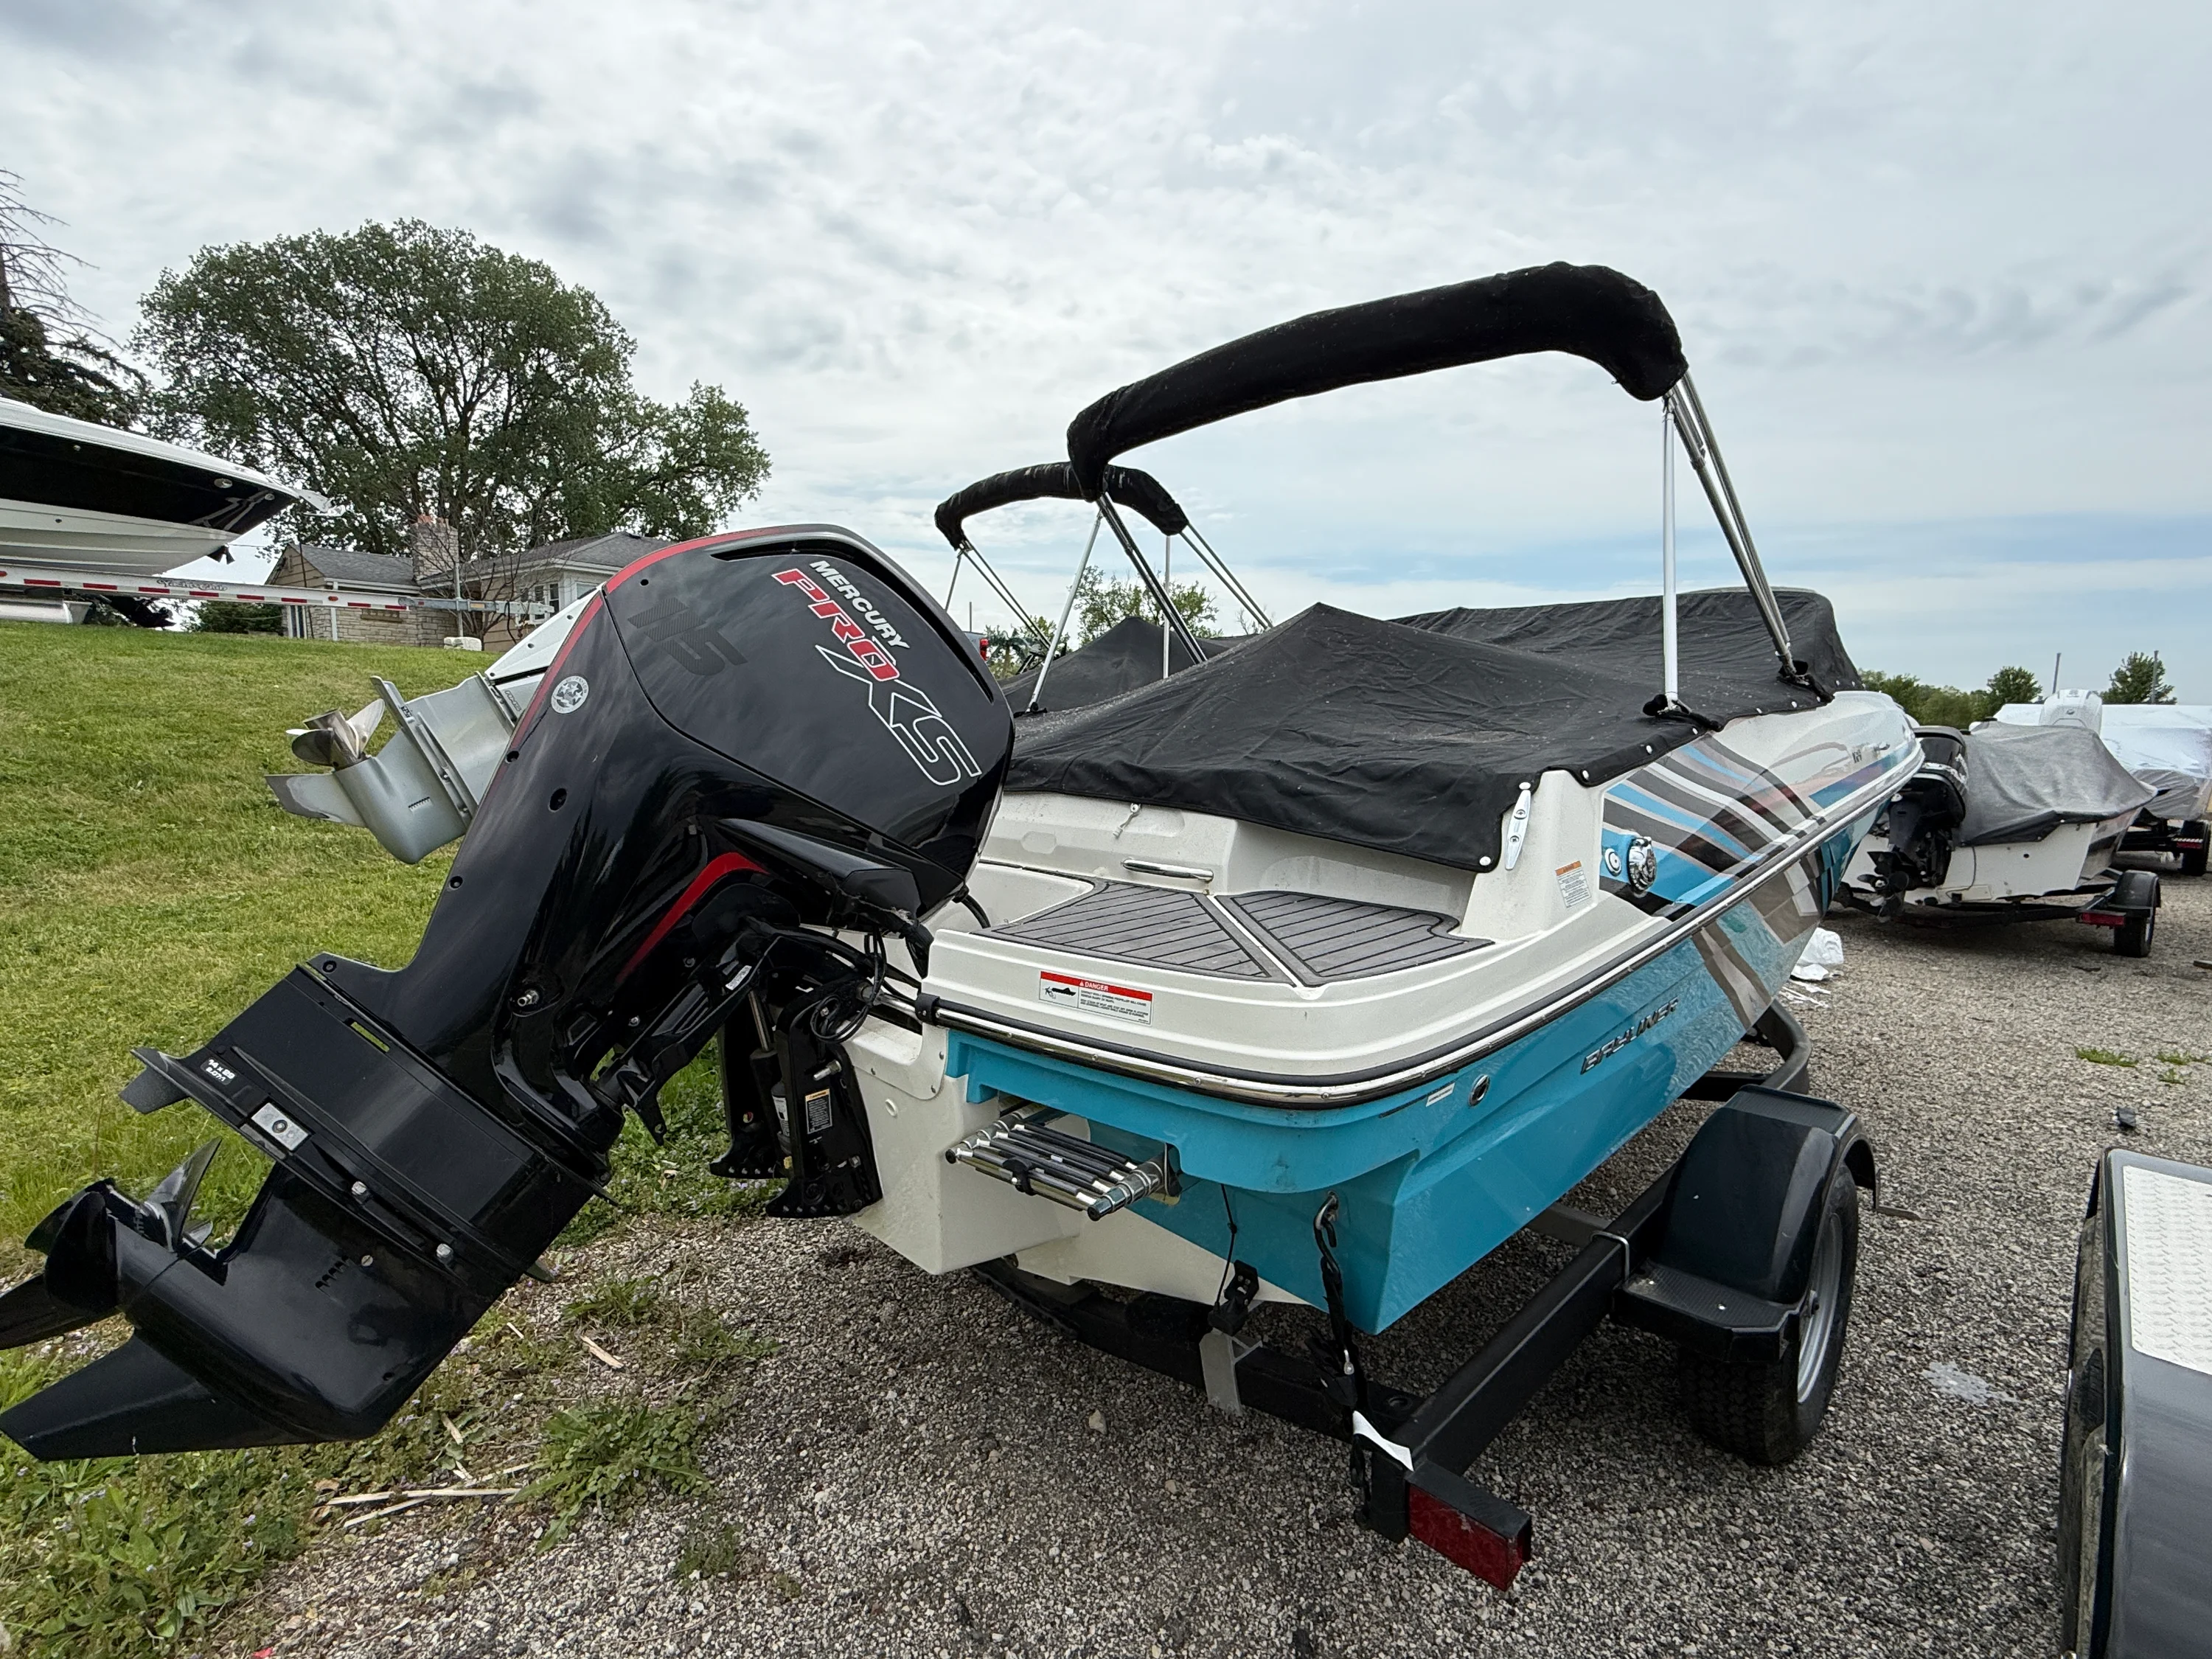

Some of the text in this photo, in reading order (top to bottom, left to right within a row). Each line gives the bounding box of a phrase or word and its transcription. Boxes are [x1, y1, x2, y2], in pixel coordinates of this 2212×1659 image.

[627, 597, 748, 675] 115
[809, 560, 911, 650] MERCURY
[771, 568, 982, 785] PRO XS
[1085, 981, 1108, 991] DANGER
[209, 1059, 219, 1068] 14
